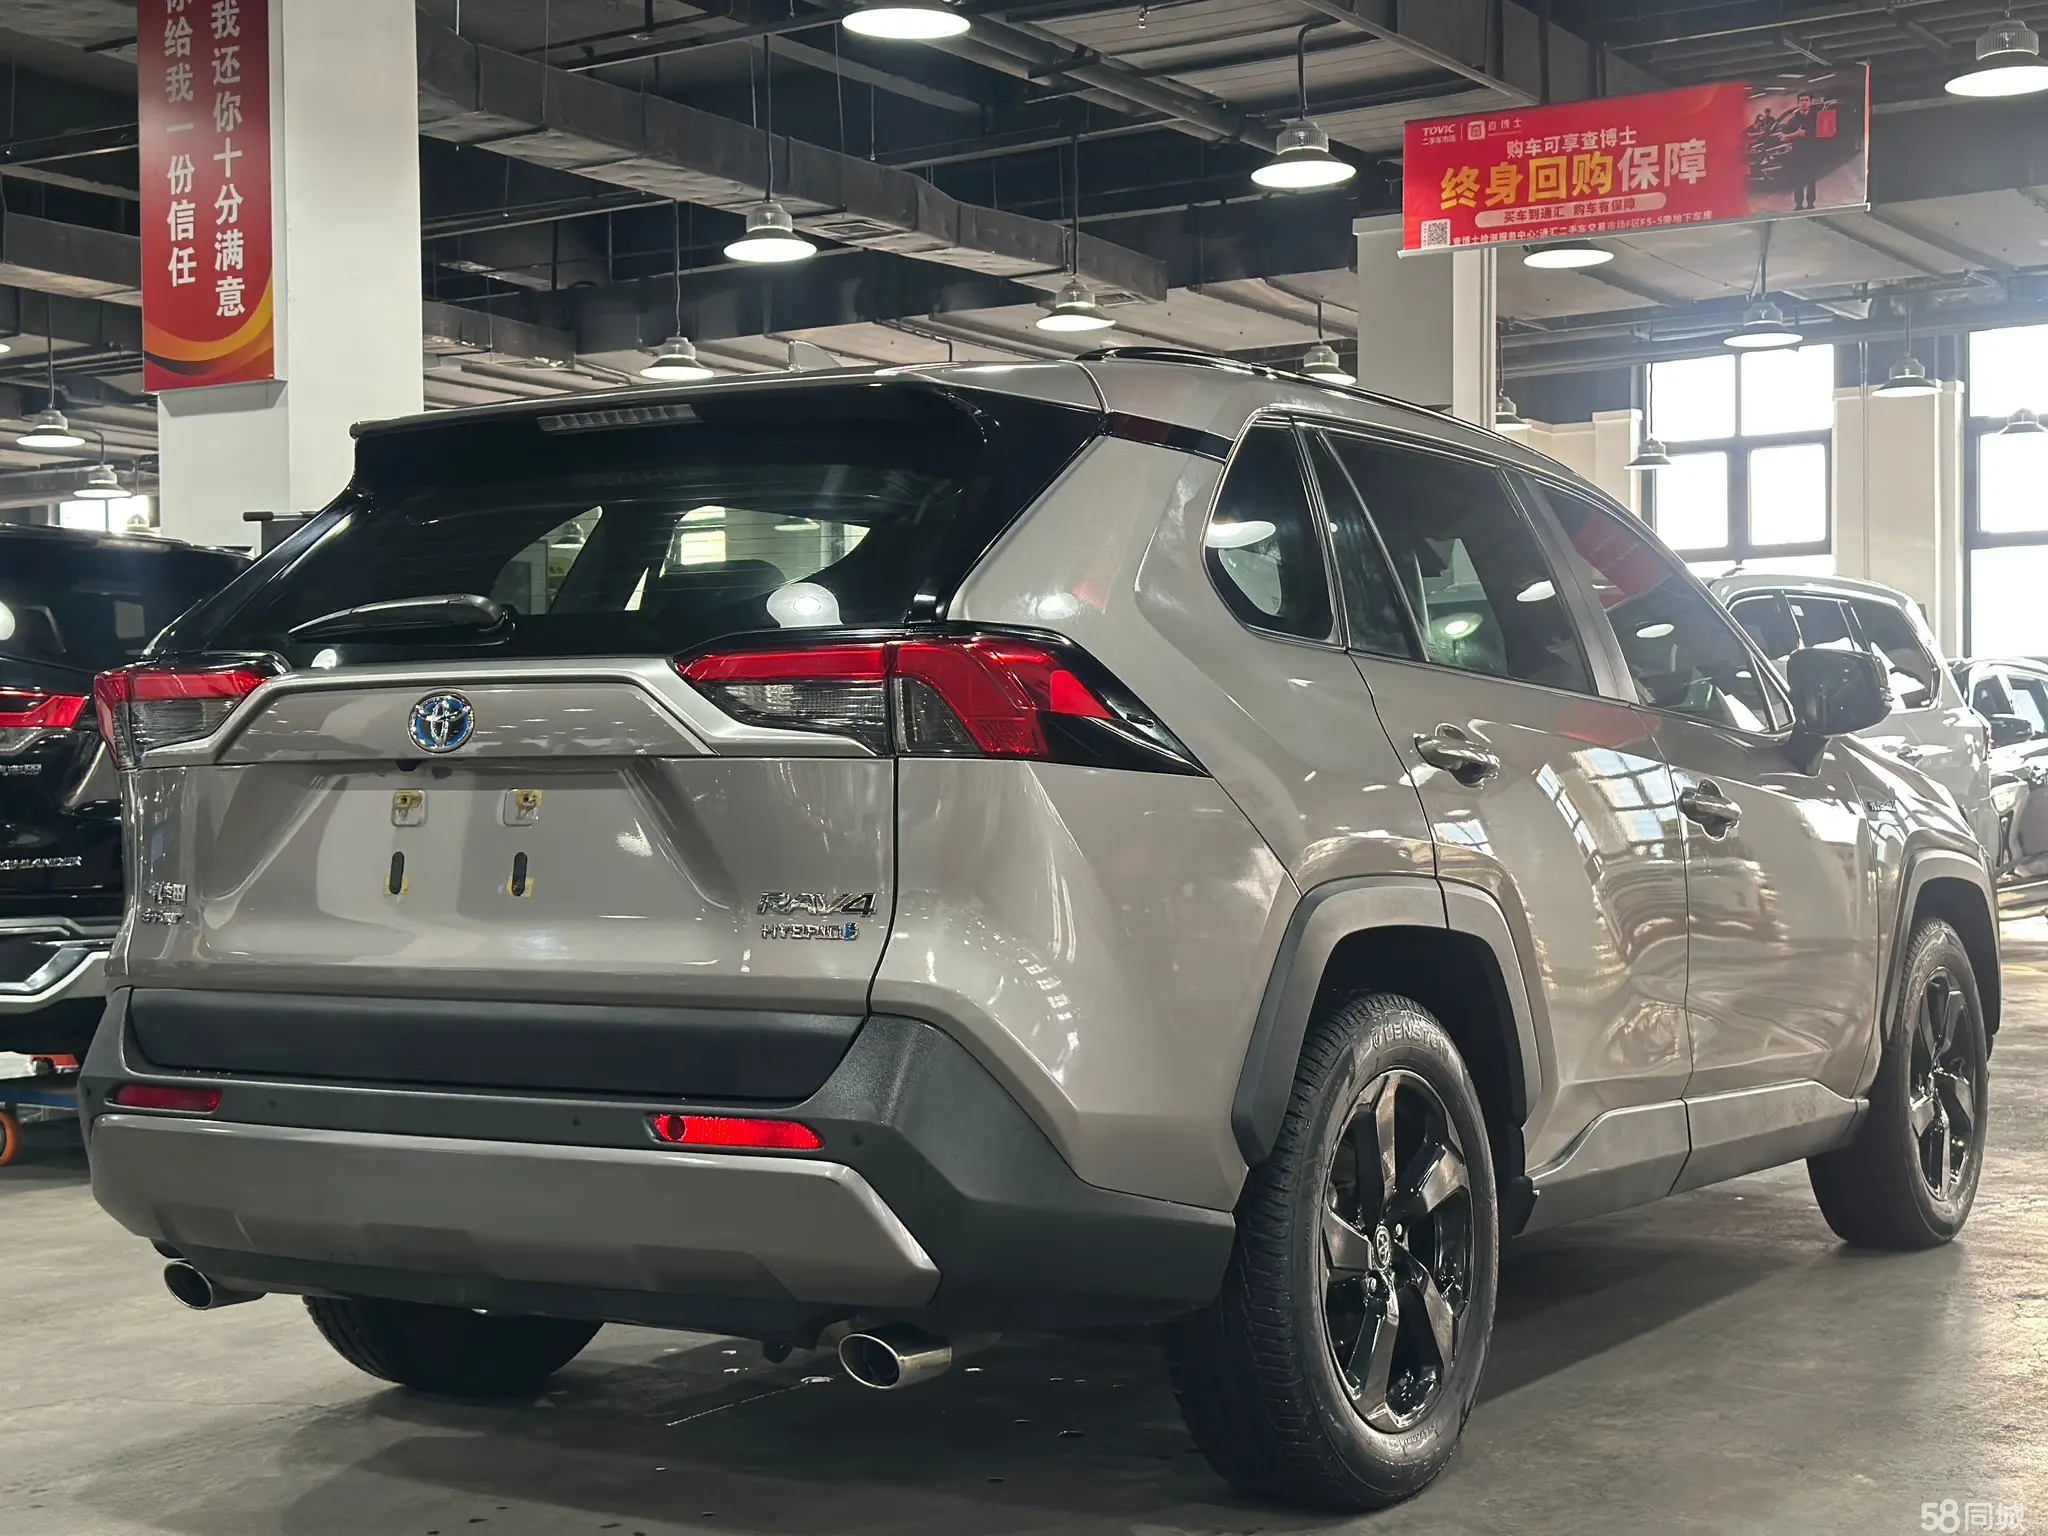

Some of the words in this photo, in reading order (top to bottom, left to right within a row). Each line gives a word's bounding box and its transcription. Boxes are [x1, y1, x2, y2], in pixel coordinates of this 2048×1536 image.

[1422, 123, 1456, 137] TOVIC
[1506, 126, 1638, 160] 购车可享查博士
[211, 0, 246, 317] 我还你十分满意
[1440, 137, 1708, 210] 终身回购保障
[1503, 205, 1565, 223] 买车到通汇
[1573, 197, 1636, 216] 购车有保障
[756, 892, 877, 917] RAV4
